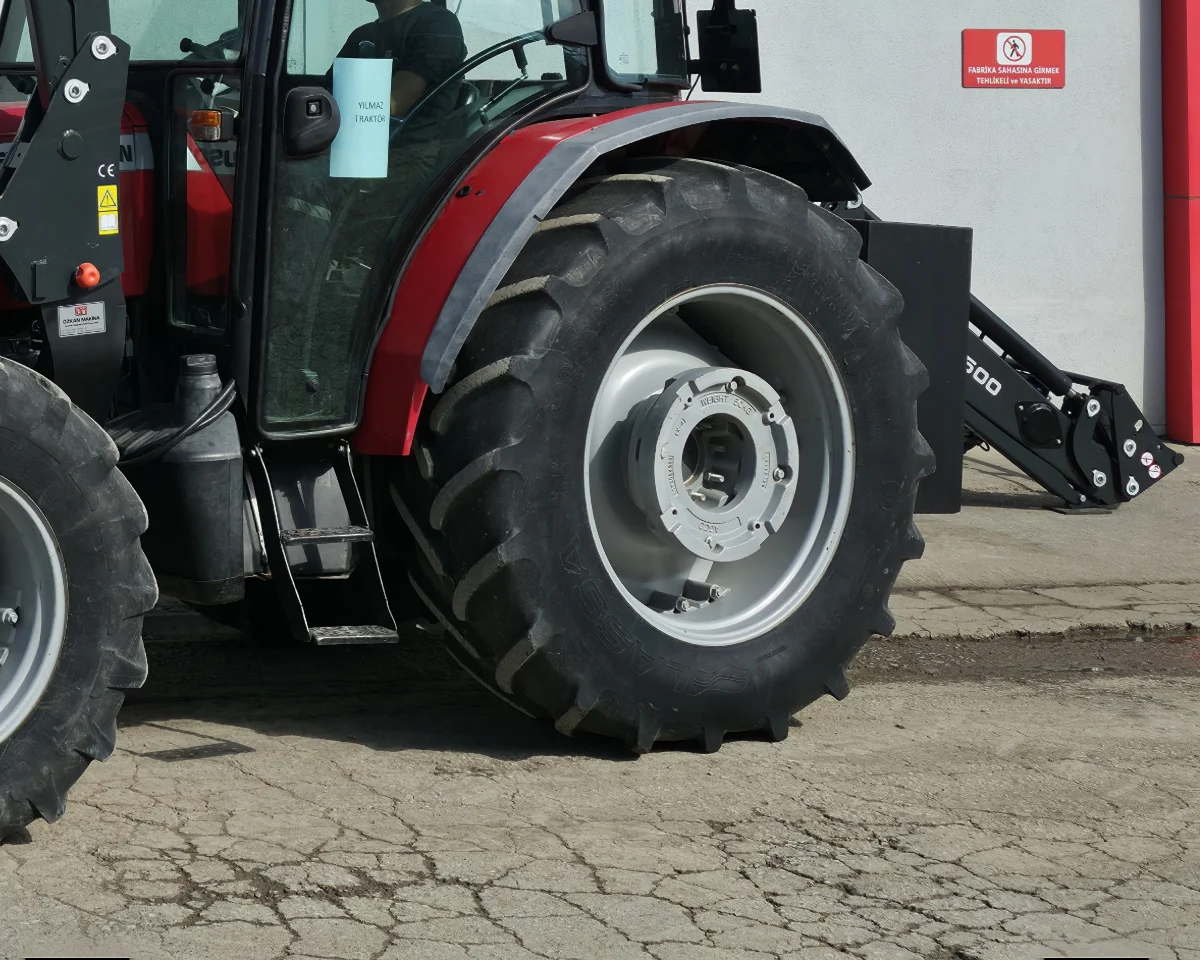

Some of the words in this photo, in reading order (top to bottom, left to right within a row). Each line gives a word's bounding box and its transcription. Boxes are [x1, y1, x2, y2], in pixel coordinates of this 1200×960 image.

[968, 66, 997, 74] FABRİKA
[1034, 66, 1060, 74] GİRMEK
[976, 76, 1009, 84] TEHLİKELİ
[98, 163, 115, 178] CE
